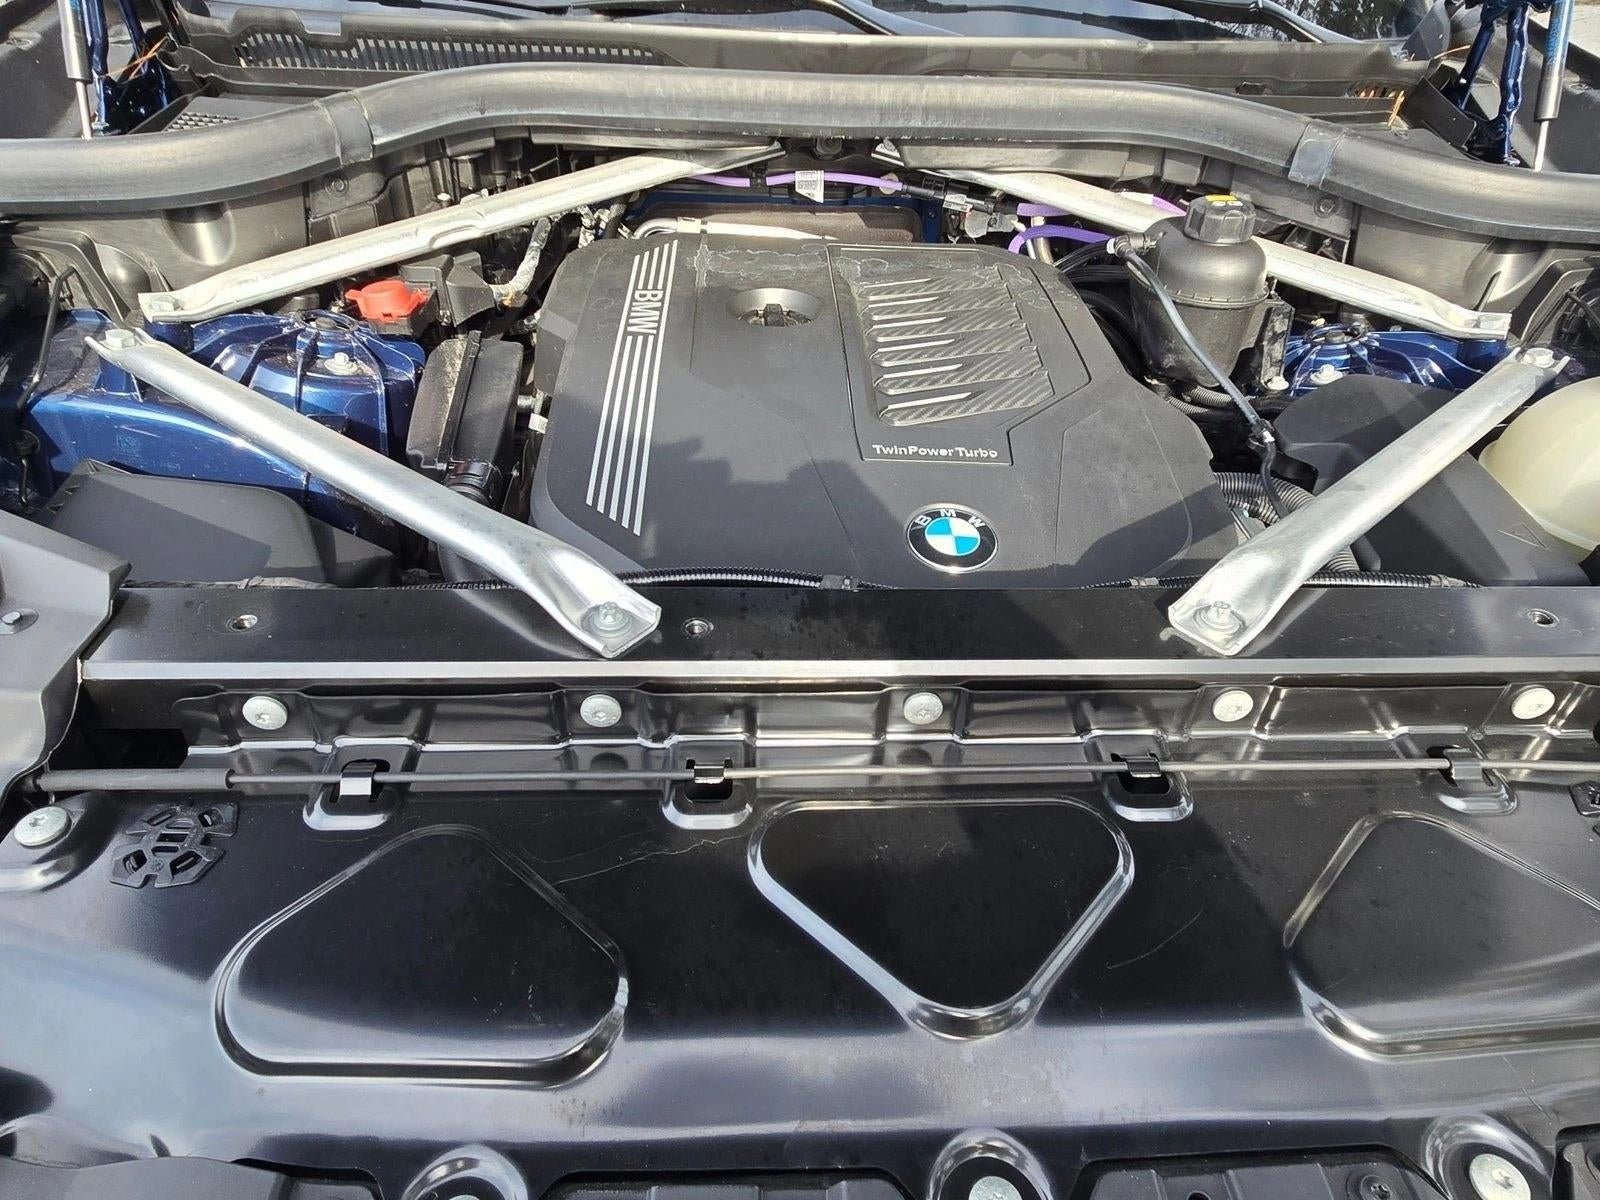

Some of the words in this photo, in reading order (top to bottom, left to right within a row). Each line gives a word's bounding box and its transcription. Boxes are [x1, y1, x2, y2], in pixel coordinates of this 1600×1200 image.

[627, 290, 664, 334] BMW
[872, 444, 954, 457] TwinPower
[954, 447, 998, 458] Turbo
[914, 508, 987, 528] BMW
